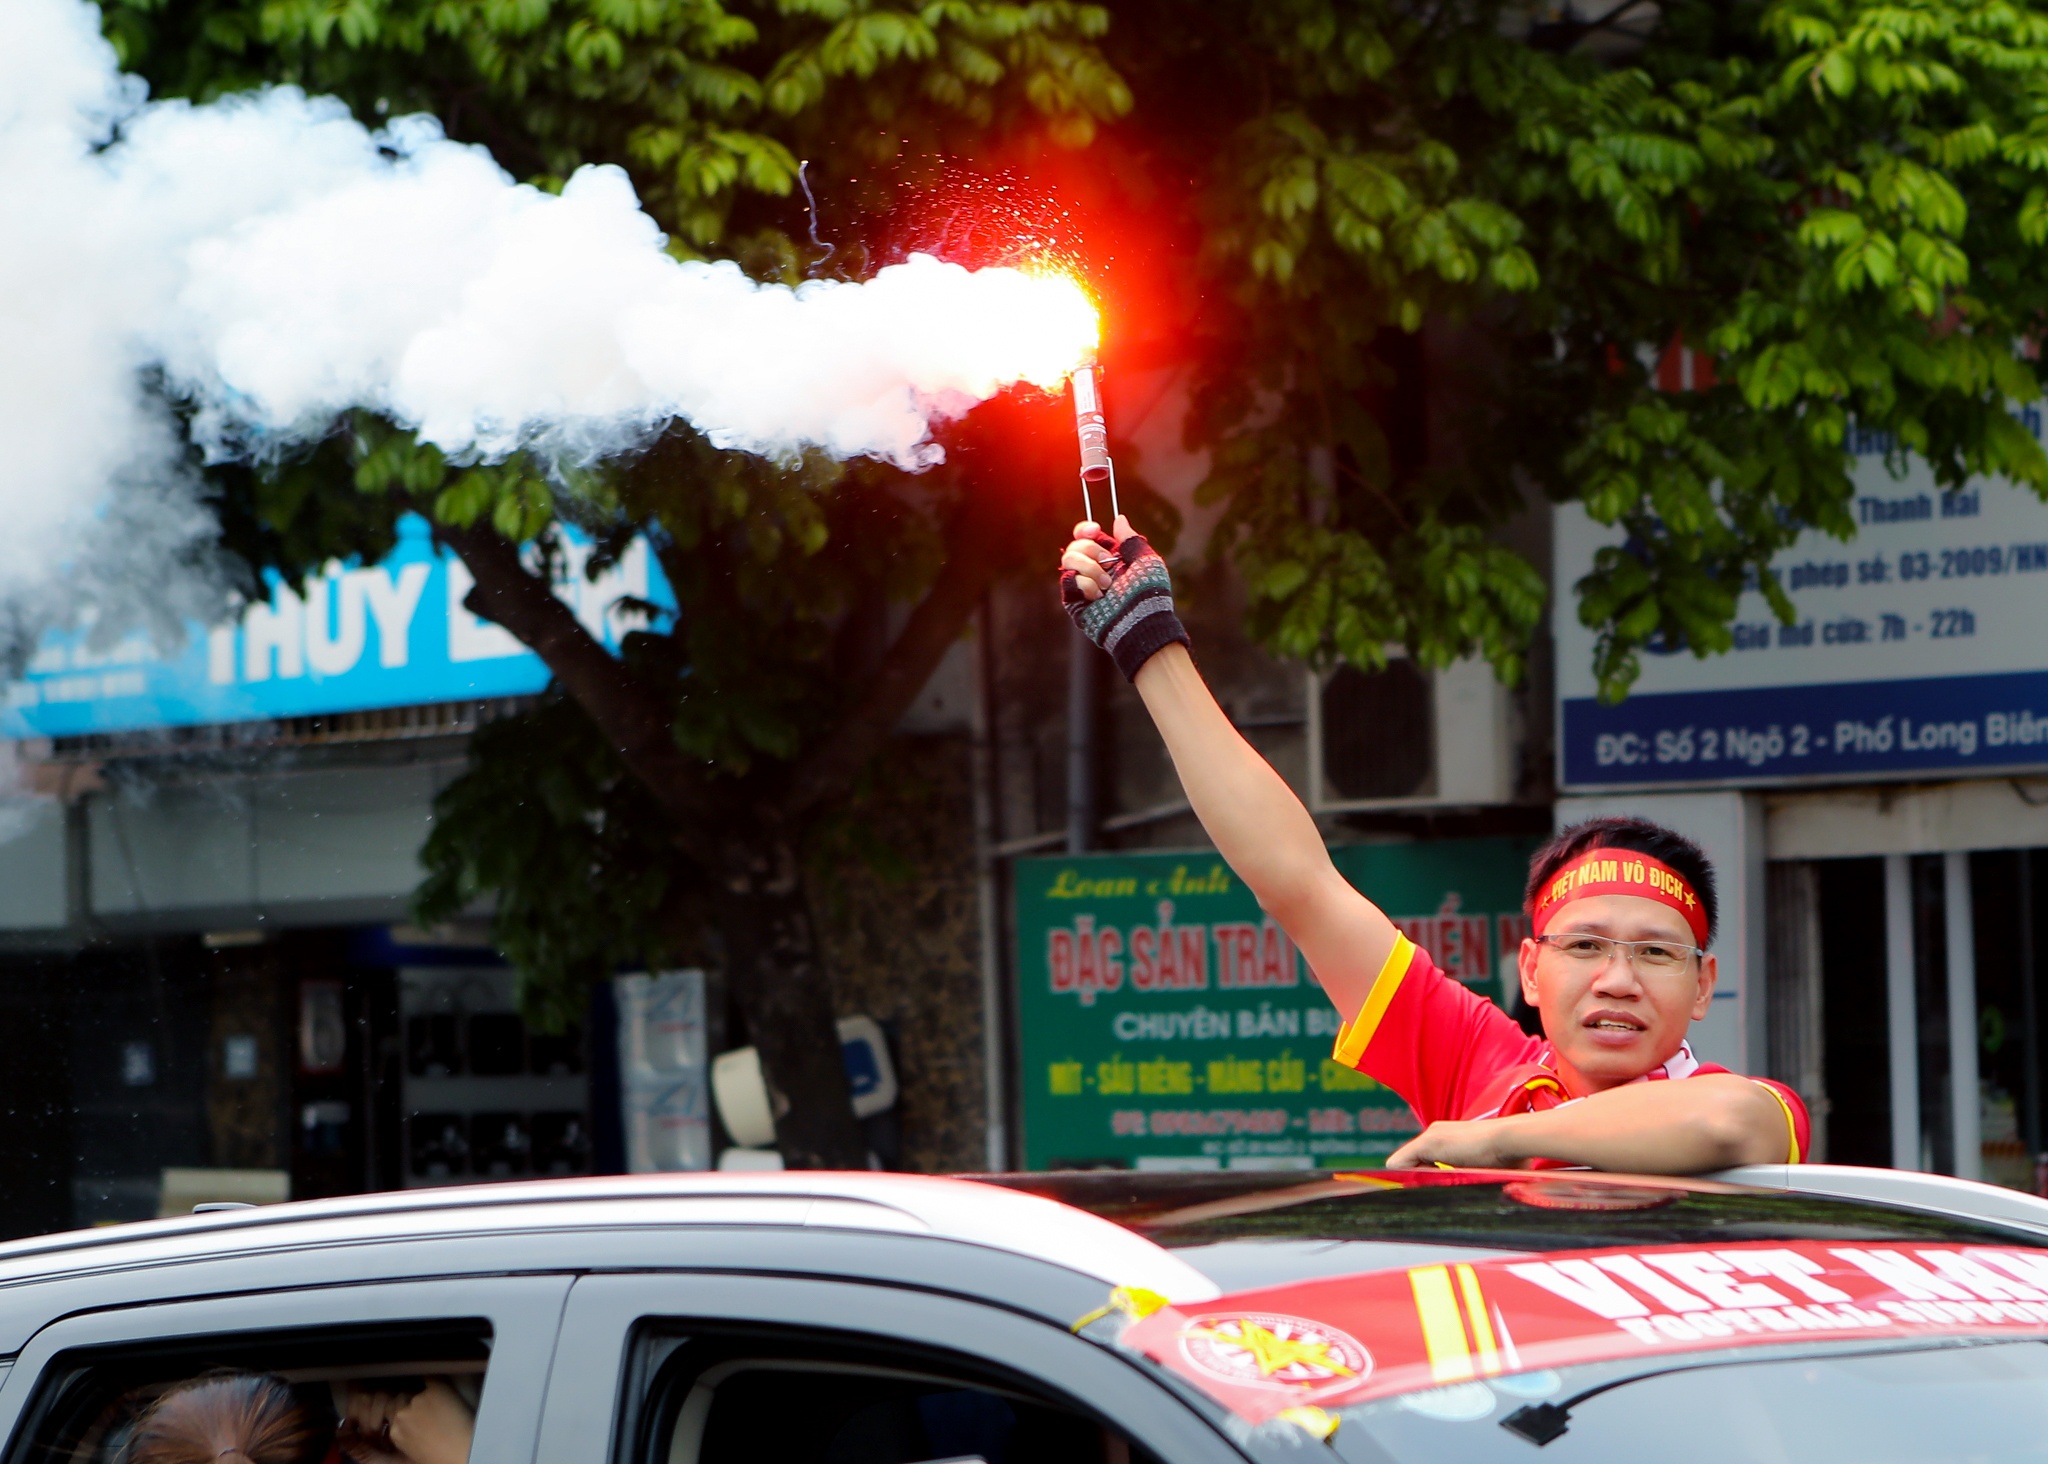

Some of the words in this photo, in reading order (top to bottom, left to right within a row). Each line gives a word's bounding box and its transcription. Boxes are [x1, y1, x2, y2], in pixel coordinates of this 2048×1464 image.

[1880, 611, 1906, 642] 7h
[1929, 603, 1976, 638] 22h
[1595, 732, 1650, 766] ĐC:
[1655, 724, 1695, 762] Số
[1701, 729, 1719, 761] 2
[1790, 725, 1810, 757] 2
[1900, 717, 1978, 757] Long
[1577, 860, 1618, 886] NAM
[1622, 859, 1646, 884] VÔ
[1649, 865, 1684, 902] ĐỊCH
[1112, 1004, 1232, 1041] CHUYÊN
[1505, 1246, 1855, 1320] VIET
[1615, 1301, 1893, 1346] FOOTBALL
